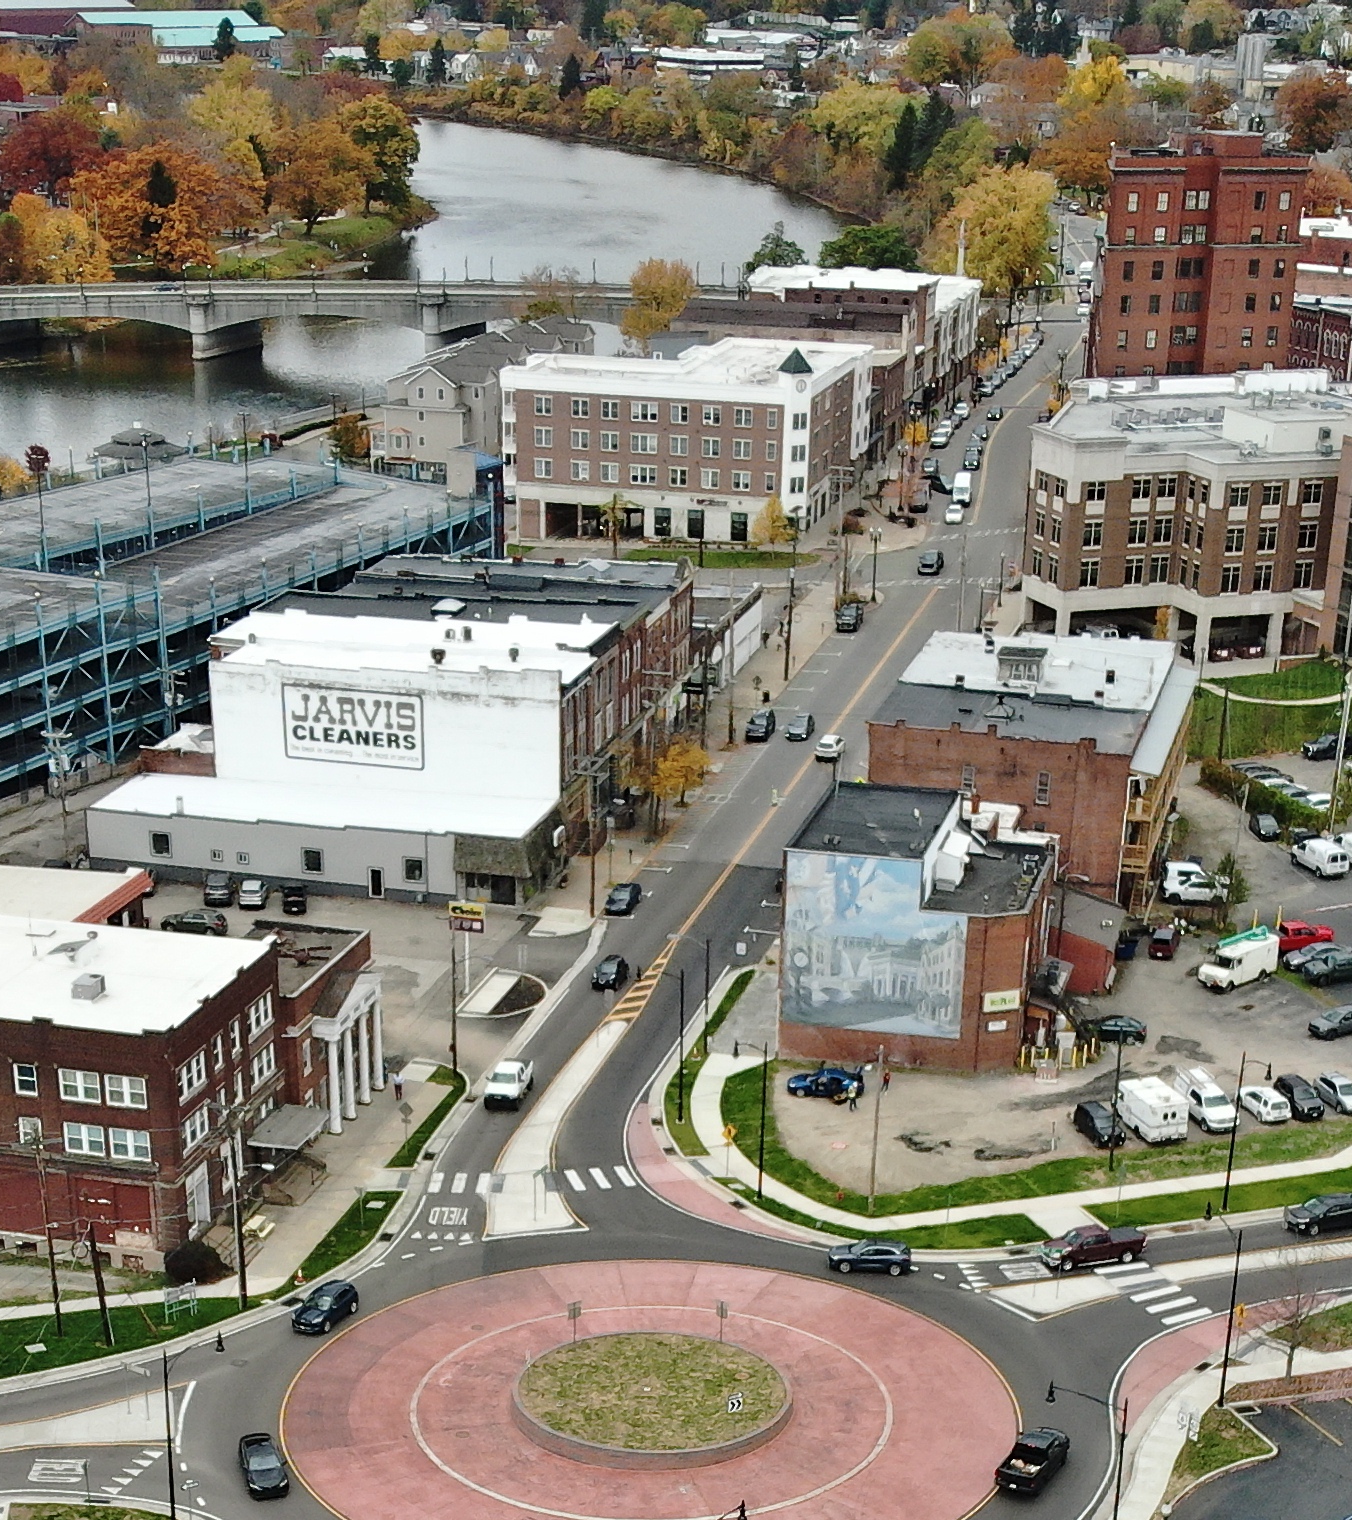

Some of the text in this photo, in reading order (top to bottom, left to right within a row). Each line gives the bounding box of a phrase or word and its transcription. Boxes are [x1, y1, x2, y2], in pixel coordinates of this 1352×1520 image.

[291, 693, 416, 732] JARVIS
[292, 724, 417, 751] CLEANERS
[428, 1206, 469, 1226] YIELD
